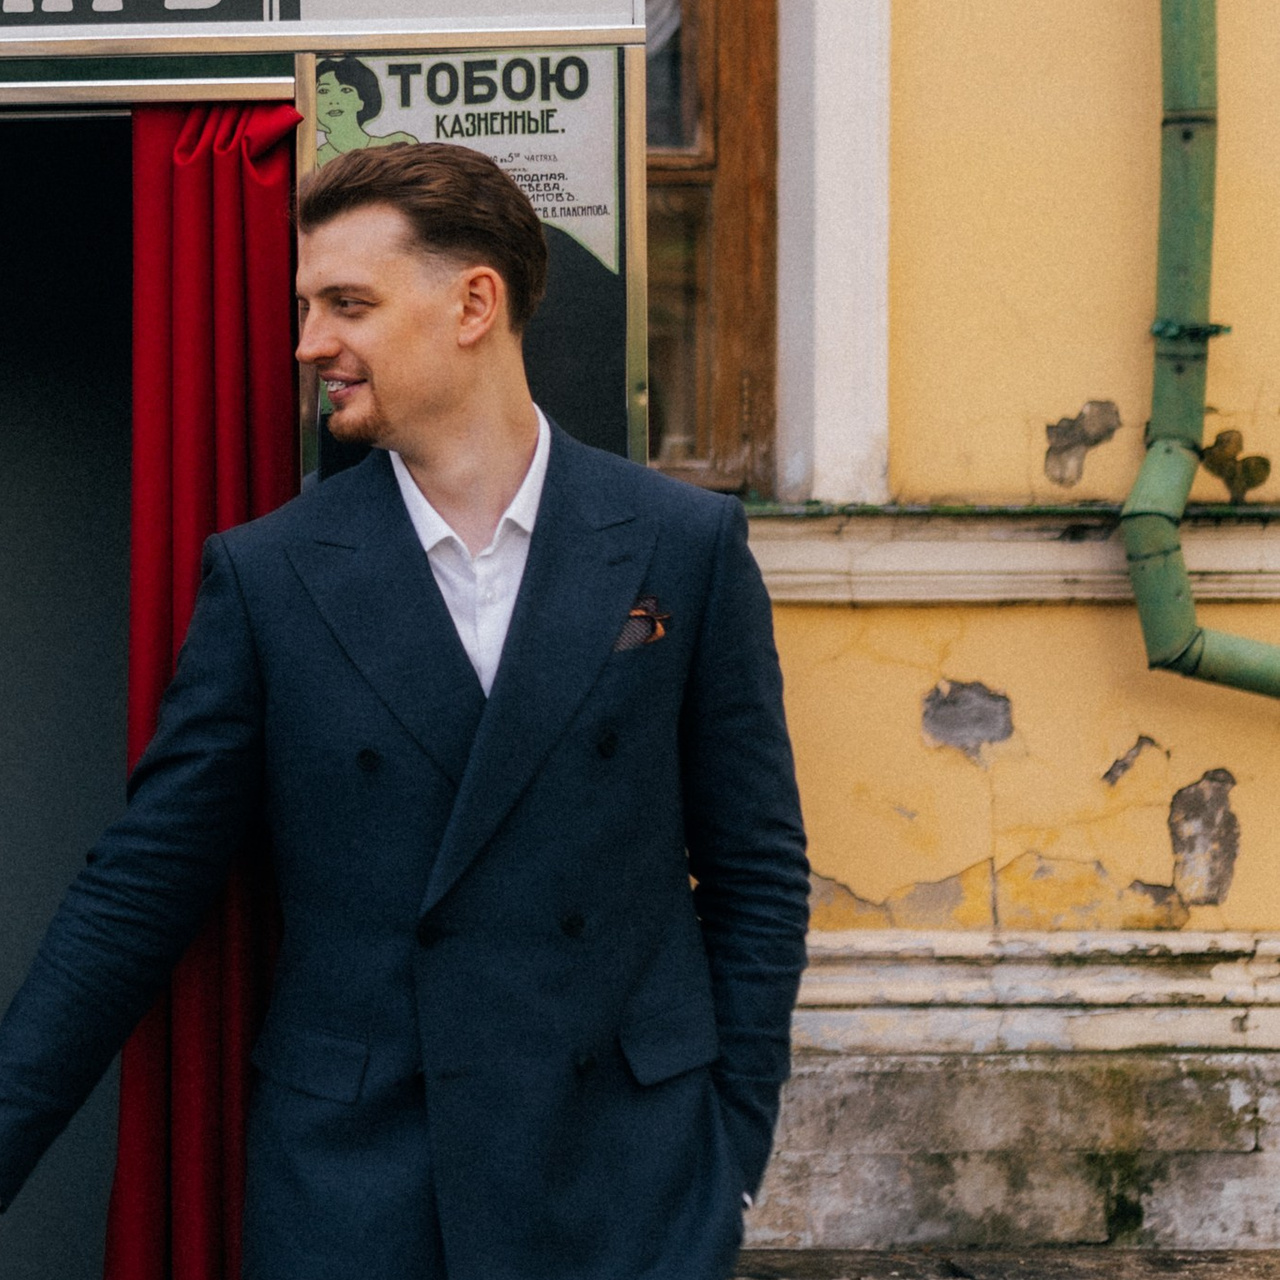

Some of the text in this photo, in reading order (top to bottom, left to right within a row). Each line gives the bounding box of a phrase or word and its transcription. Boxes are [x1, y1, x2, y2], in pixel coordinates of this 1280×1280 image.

[387, 56, 590, 109] ТОБОЮ
[435, 109, 567, 140] КАЗНЕННЫЕ.
[510, 172, 569, 182] ОЛОДНАЯ.
[528, 193, 578, 202] ИМОВЪ.
